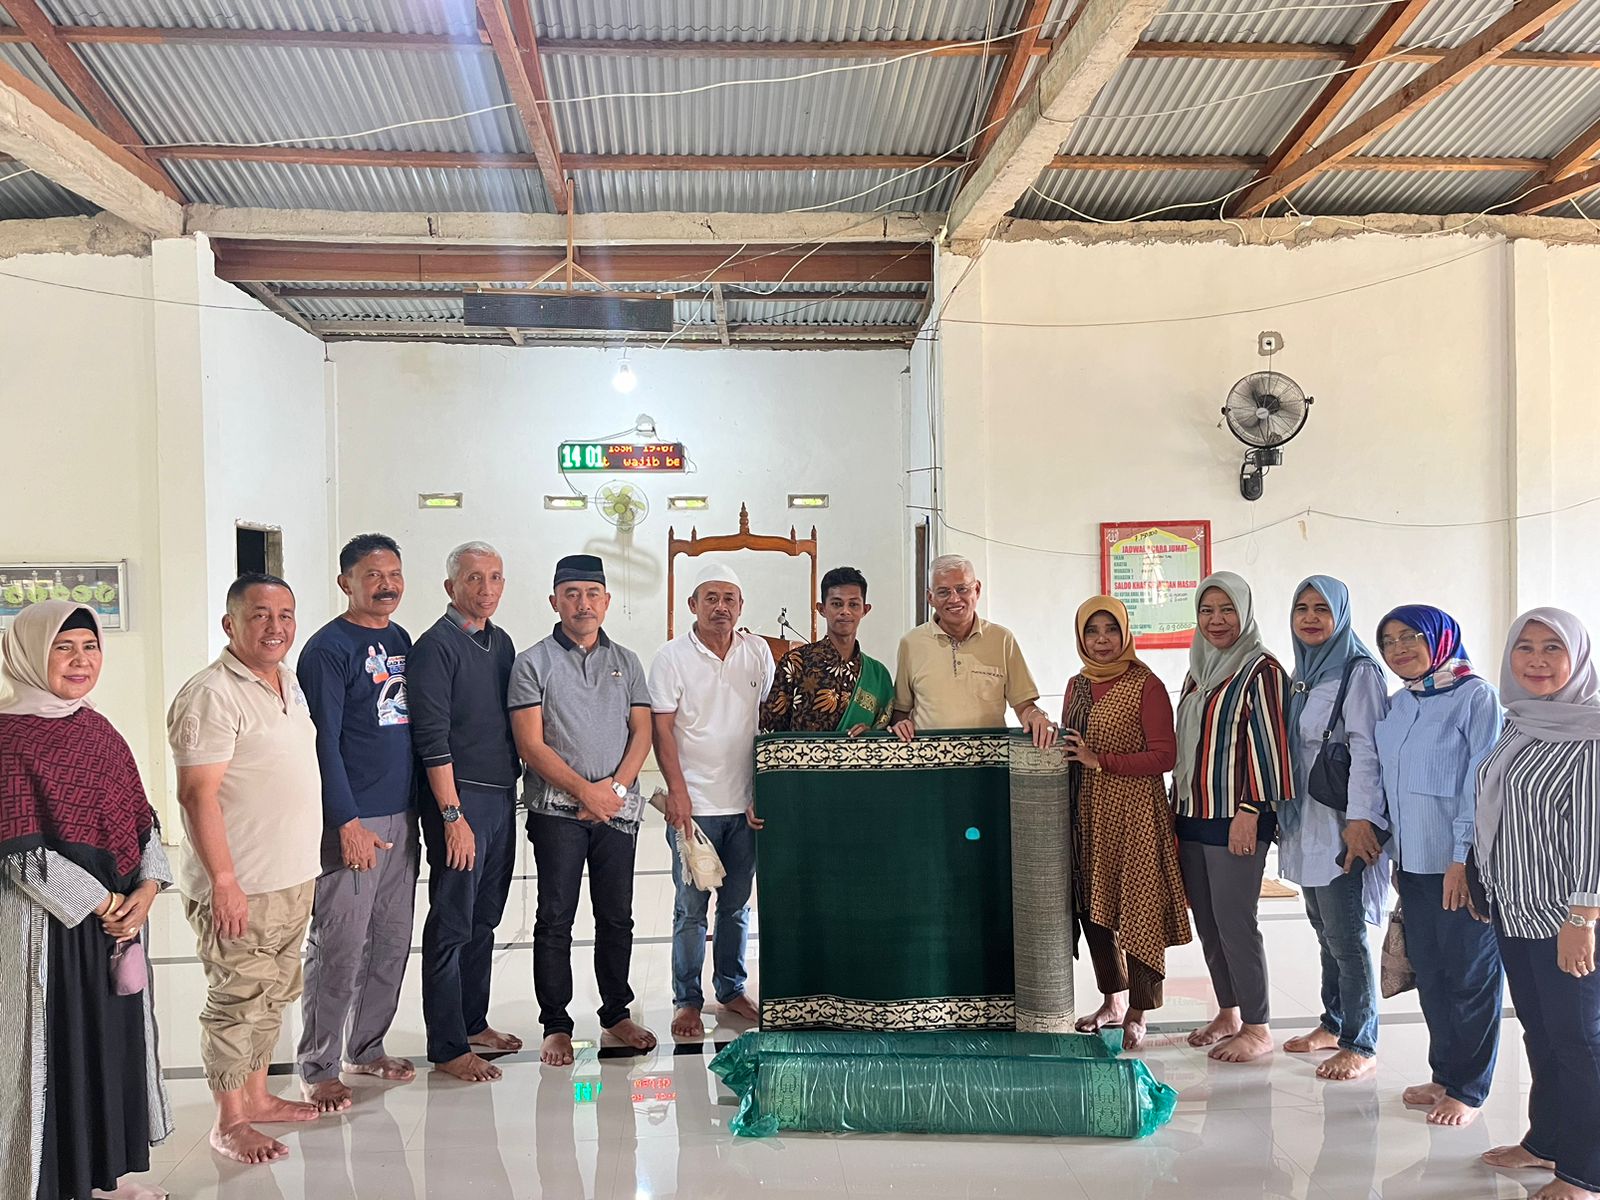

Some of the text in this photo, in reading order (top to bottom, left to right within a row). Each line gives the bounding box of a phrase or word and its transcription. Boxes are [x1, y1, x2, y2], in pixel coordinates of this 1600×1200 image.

[562, 445, 604, 468] 14 01
[623, 456, 660, 468] wajib
[666, 456, 681, 467] be
